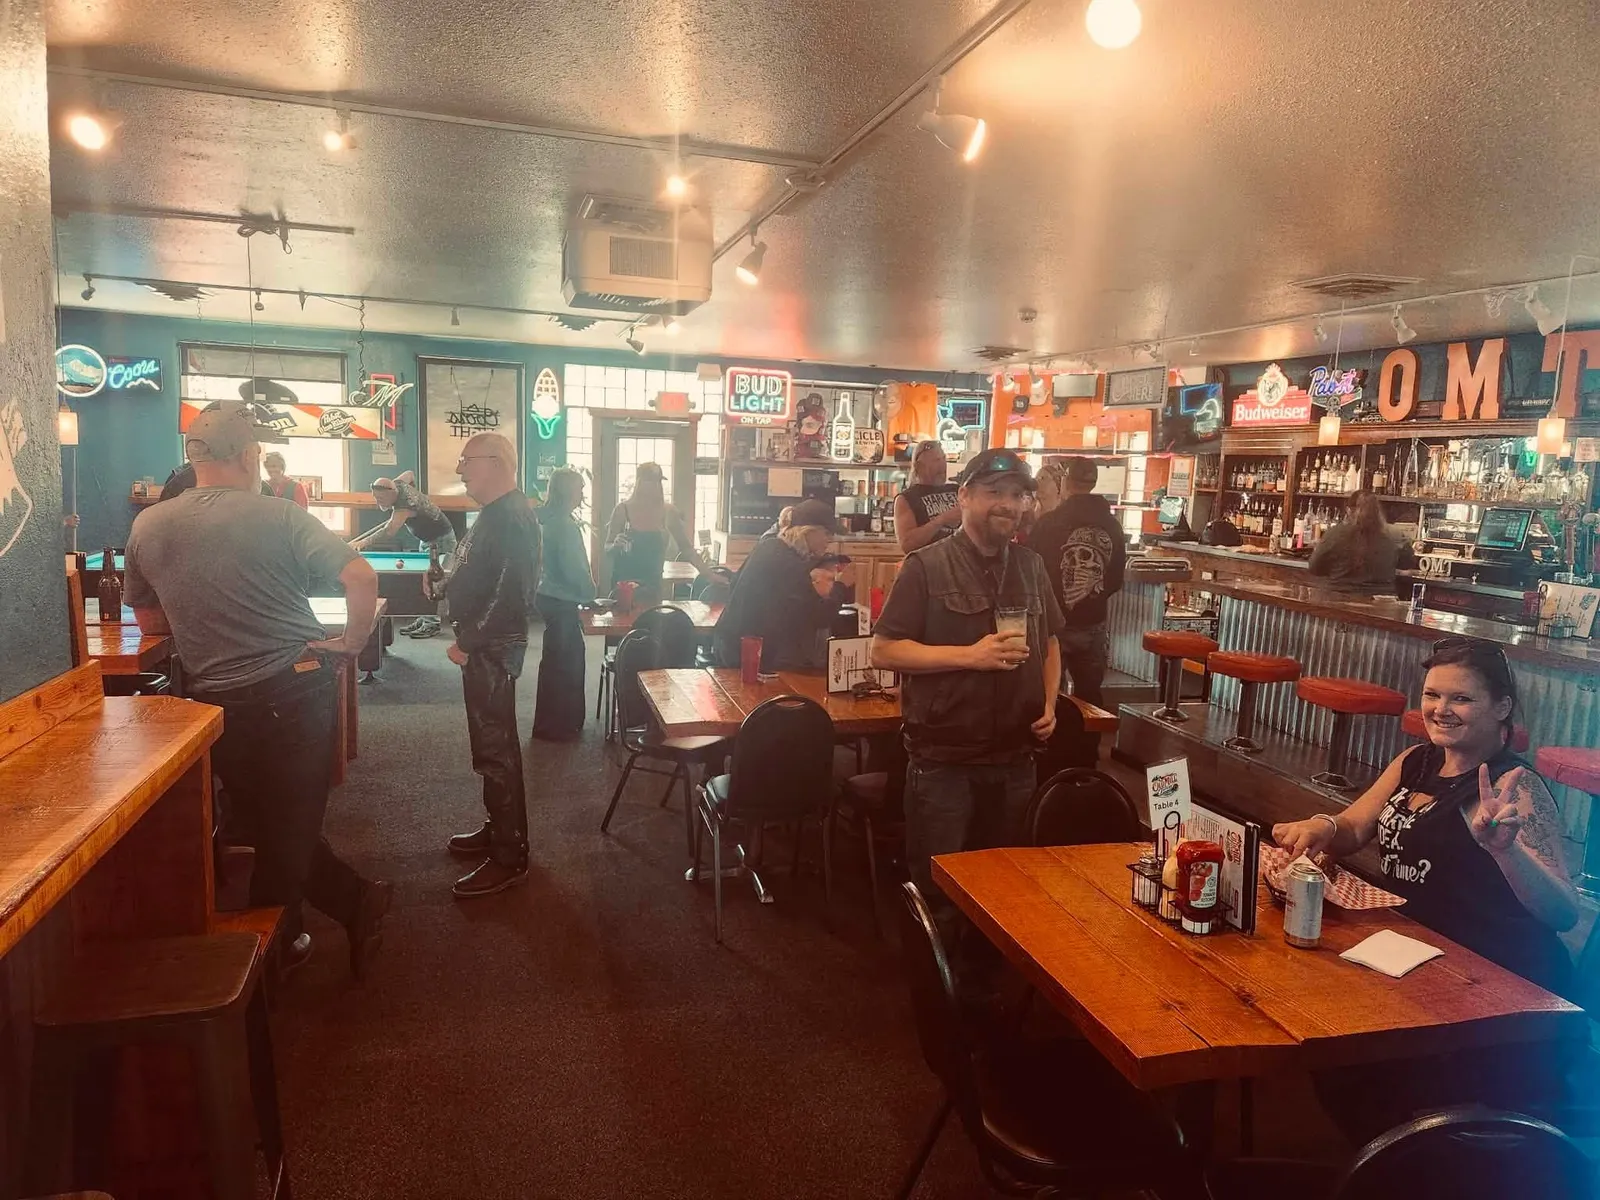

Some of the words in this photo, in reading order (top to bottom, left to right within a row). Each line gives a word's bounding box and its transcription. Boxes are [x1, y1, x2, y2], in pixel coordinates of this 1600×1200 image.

[107, 359, 159, 389] Coors
[1308, 366, 1357, 396] Pabst
[735, 374, 782, 396] BUD
[729, 395, 784, 412] LIGHT
[1235, 403, 1309, 421] Budweiser
[756, 417, 772, 425] TAP
[854, 430, 880, 441] CICLE
[1153, 802, 1173, 811] Table
[1174, 799, 1179, 807] 4
